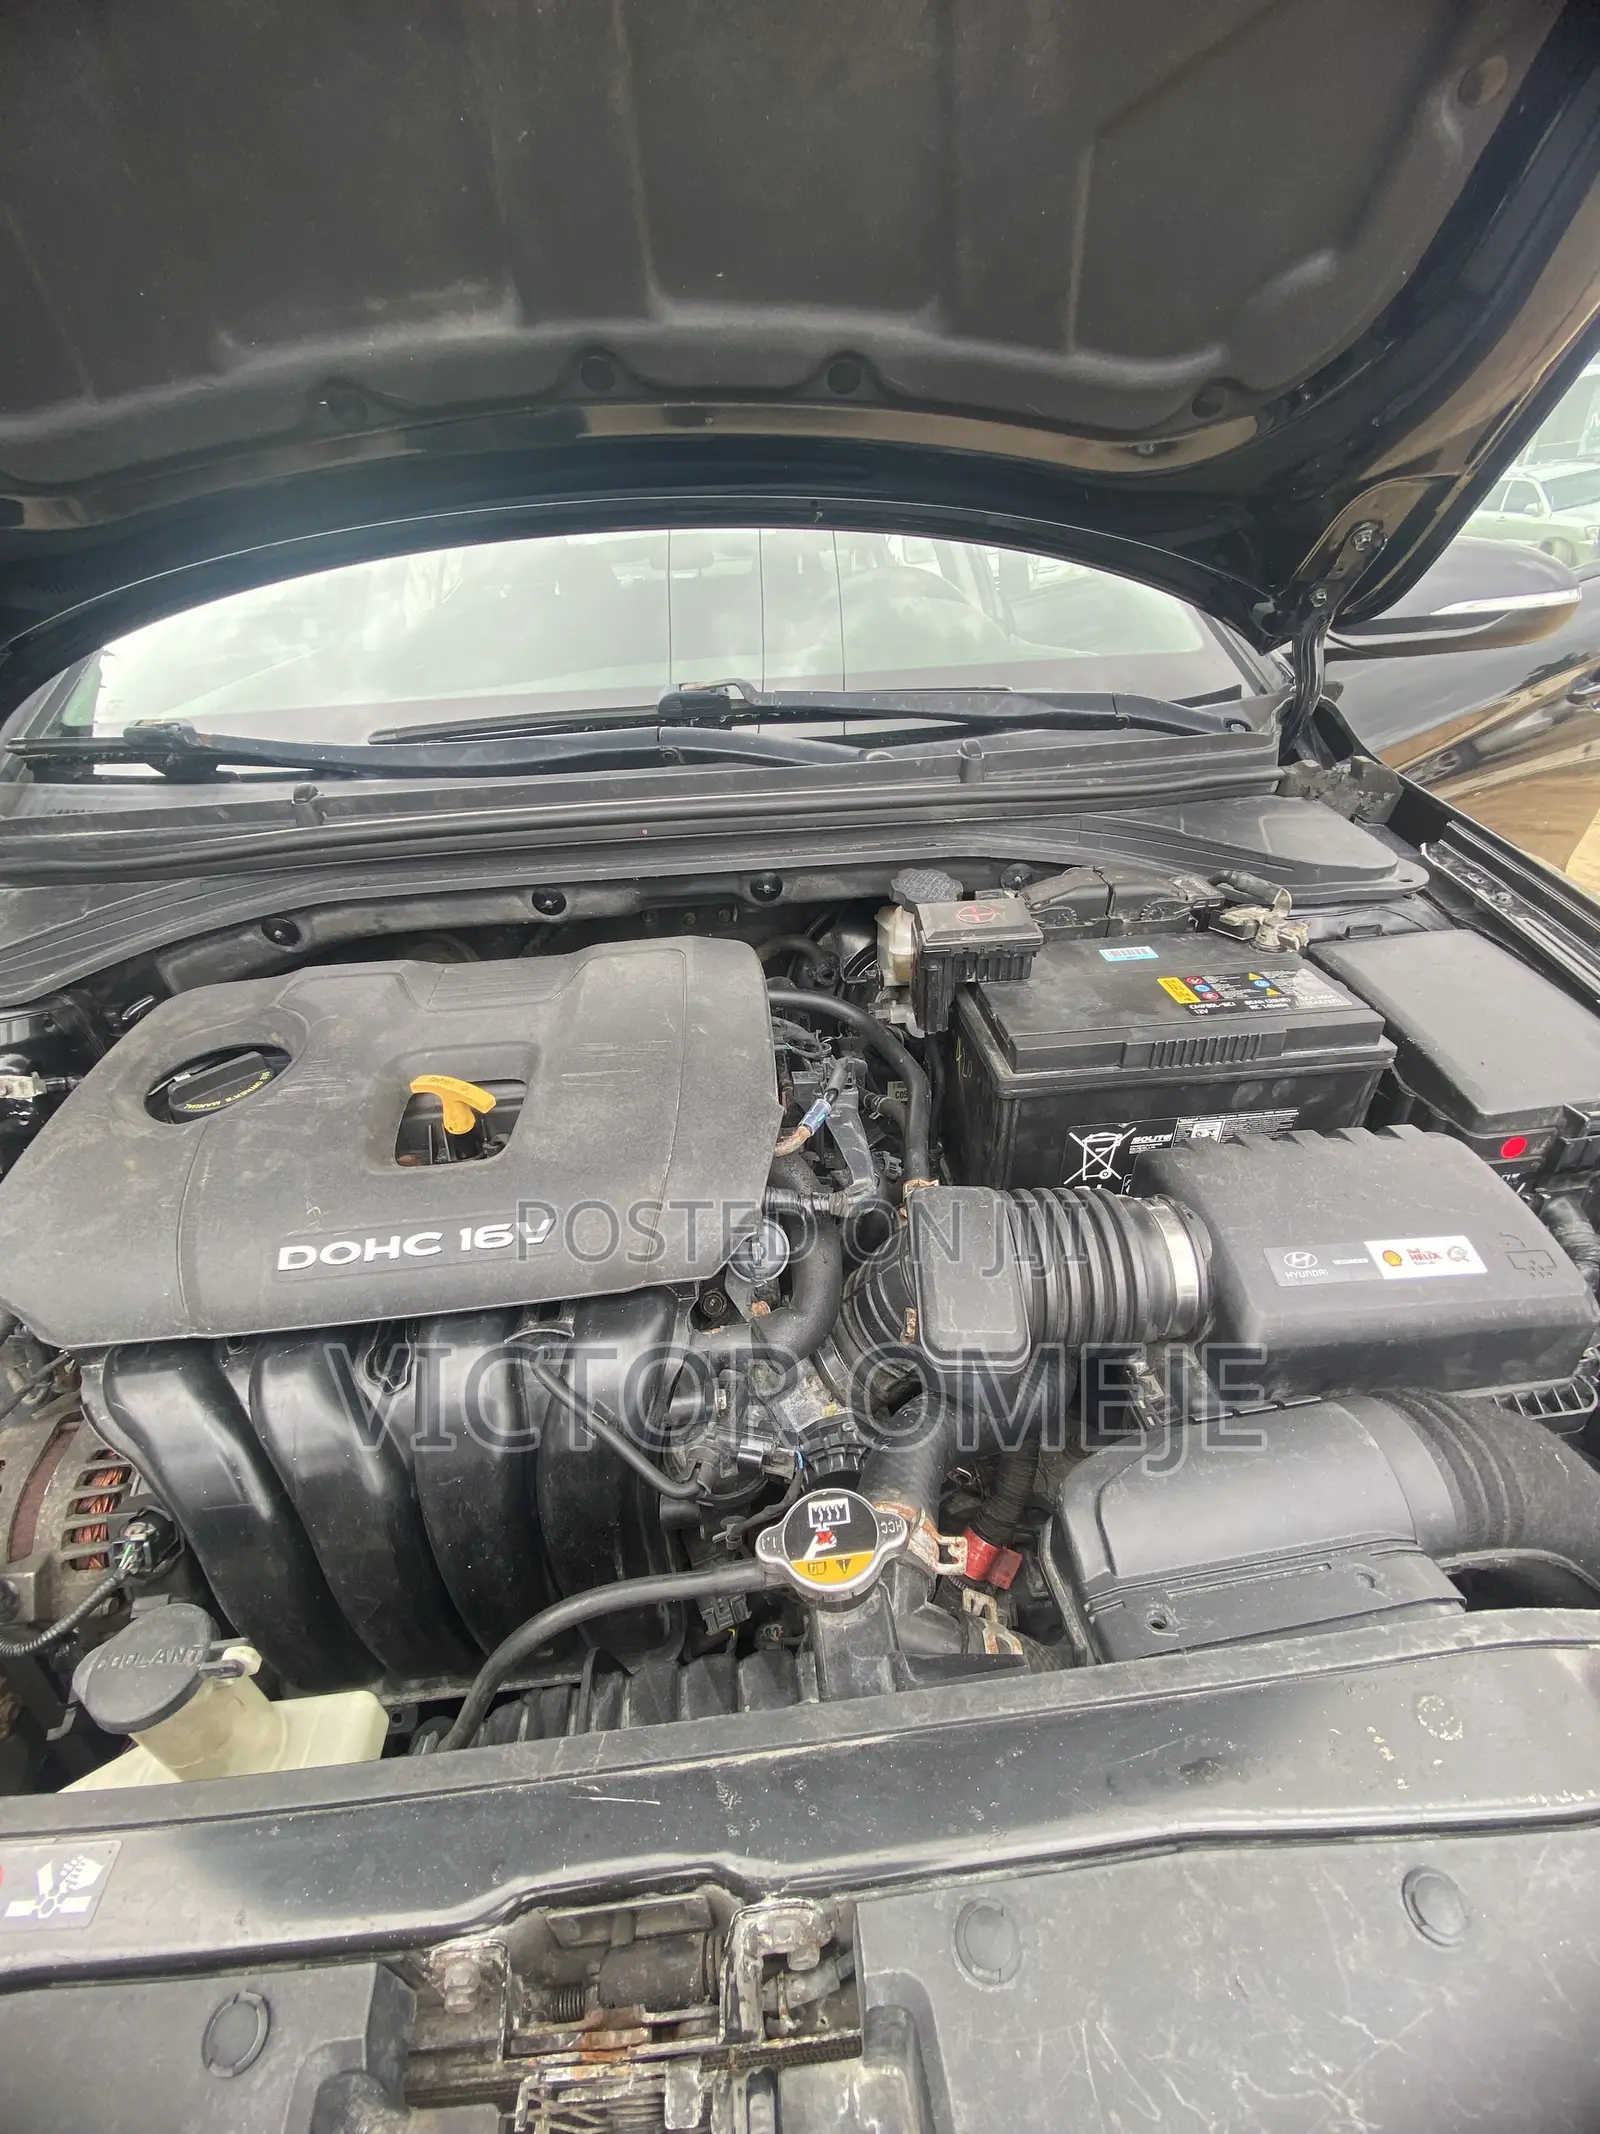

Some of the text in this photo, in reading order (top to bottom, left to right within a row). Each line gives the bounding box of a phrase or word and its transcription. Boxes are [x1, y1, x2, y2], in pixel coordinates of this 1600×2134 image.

[183, 1100, 222, 1110] MANUAL
[277, 1218, 556, 1271] DOHC 16V
[1284, 1268, 1329, 1279] HYUNDAI
[93, 1643, 205, 1671] COOLANT
